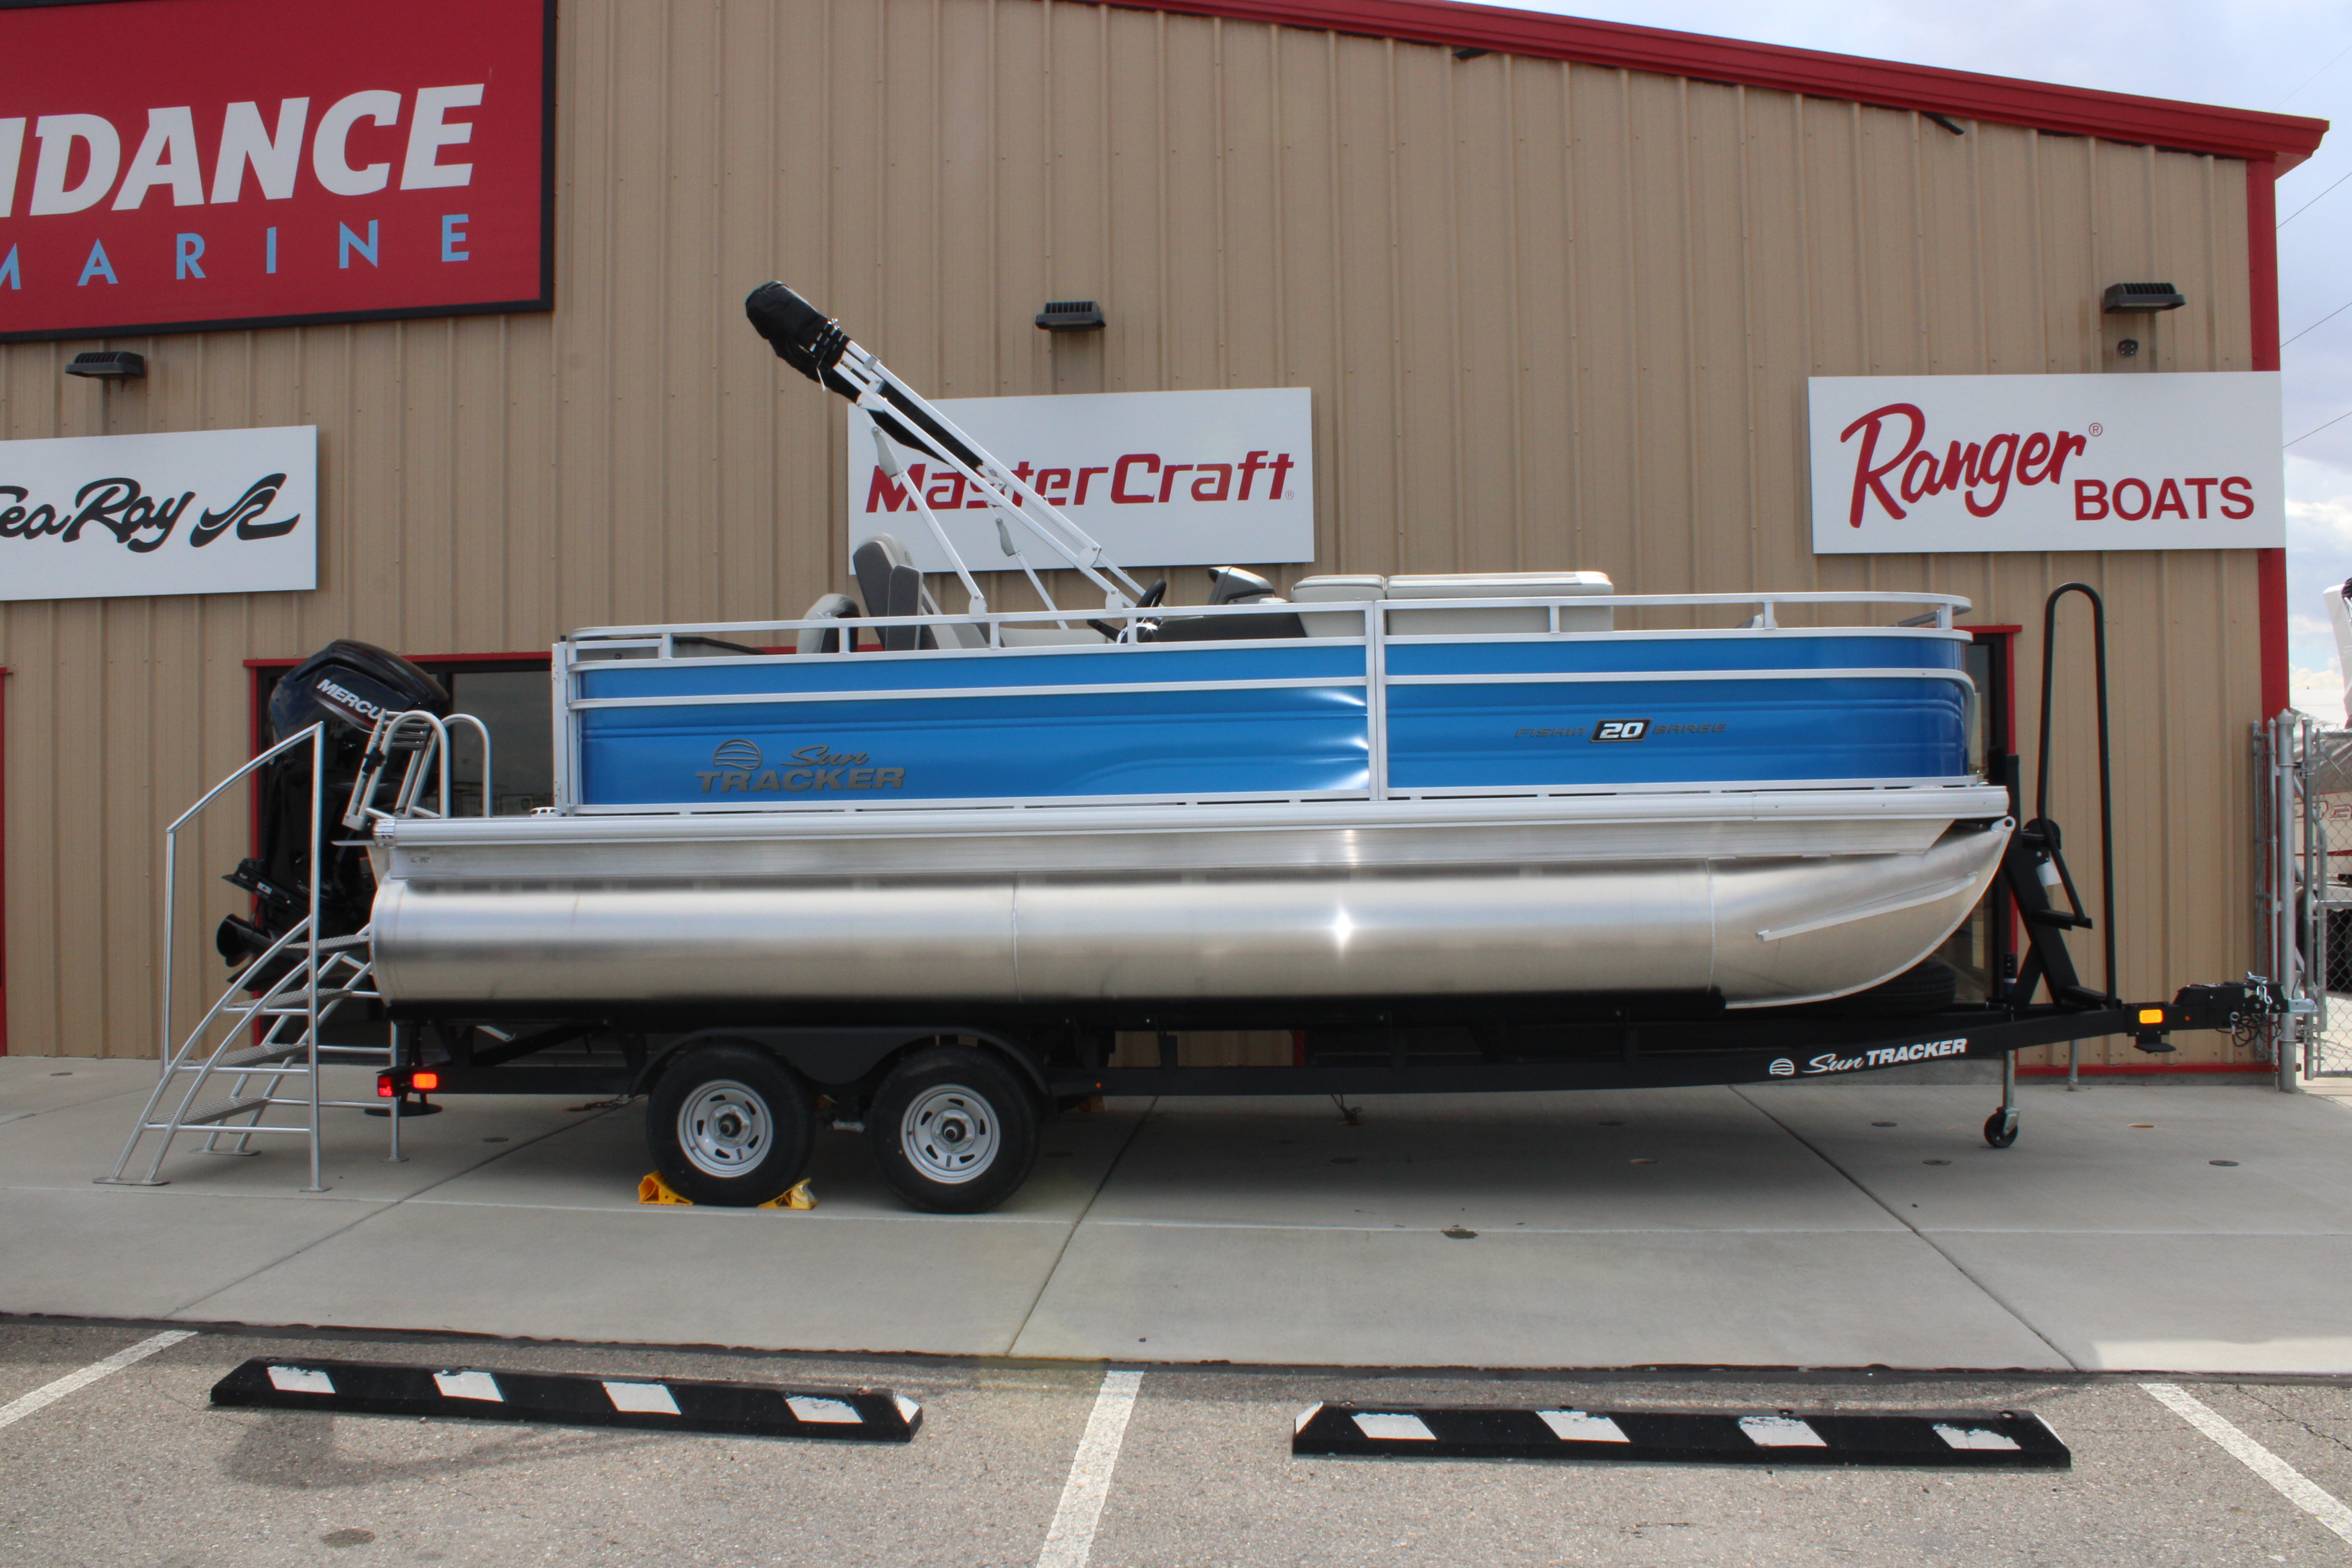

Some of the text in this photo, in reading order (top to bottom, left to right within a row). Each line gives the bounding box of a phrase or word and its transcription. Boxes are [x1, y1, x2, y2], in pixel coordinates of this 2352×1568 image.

[865, 450, 1294, 512] MasterCraft
[1840, 403, 2086, 528] Ranger
[63, 477, 196, 553] Ray
[2075, 476, 2255, 521] BOATS
[1599, 722, 1644, 739] 20
[1652, 723, 1727, 734] BARGE
[780, 745, 870, 767] Sun
[695, 767, 906, 793] TRACKER
[1802, 1038, 1967, 1074] Sun TRACKER
